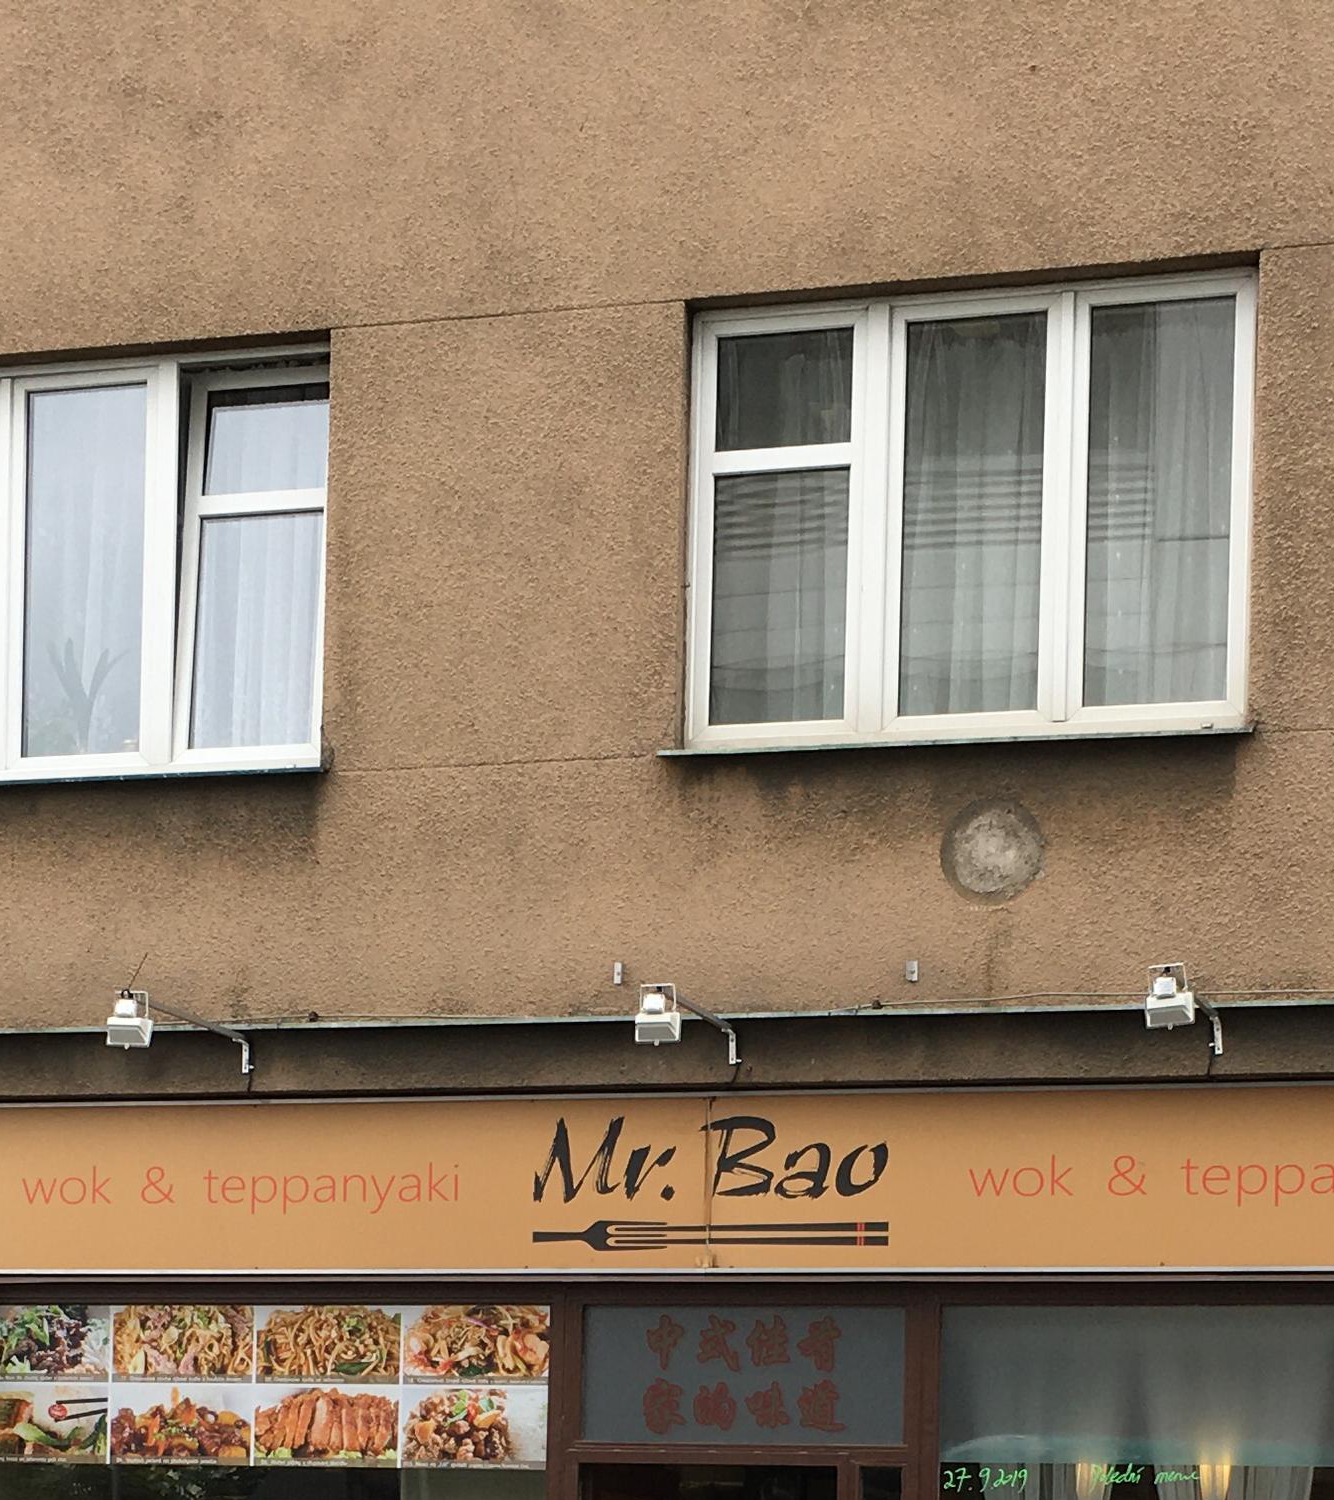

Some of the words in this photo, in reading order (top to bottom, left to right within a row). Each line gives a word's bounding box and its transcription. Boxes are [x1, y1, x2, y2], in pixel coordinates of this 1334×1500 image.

[533, 1116, 677, 1204] Mr.
[700, 1115, 889, 1200] Bao
[969, 1154, 1074, 1197] wok
[1107, 1155, 1147, 1197] &
[22, 1166, 113, 1205] wok
[140, 1166, 175, 1205] &
[202, 1163, 461, 1215] teppanyaki
